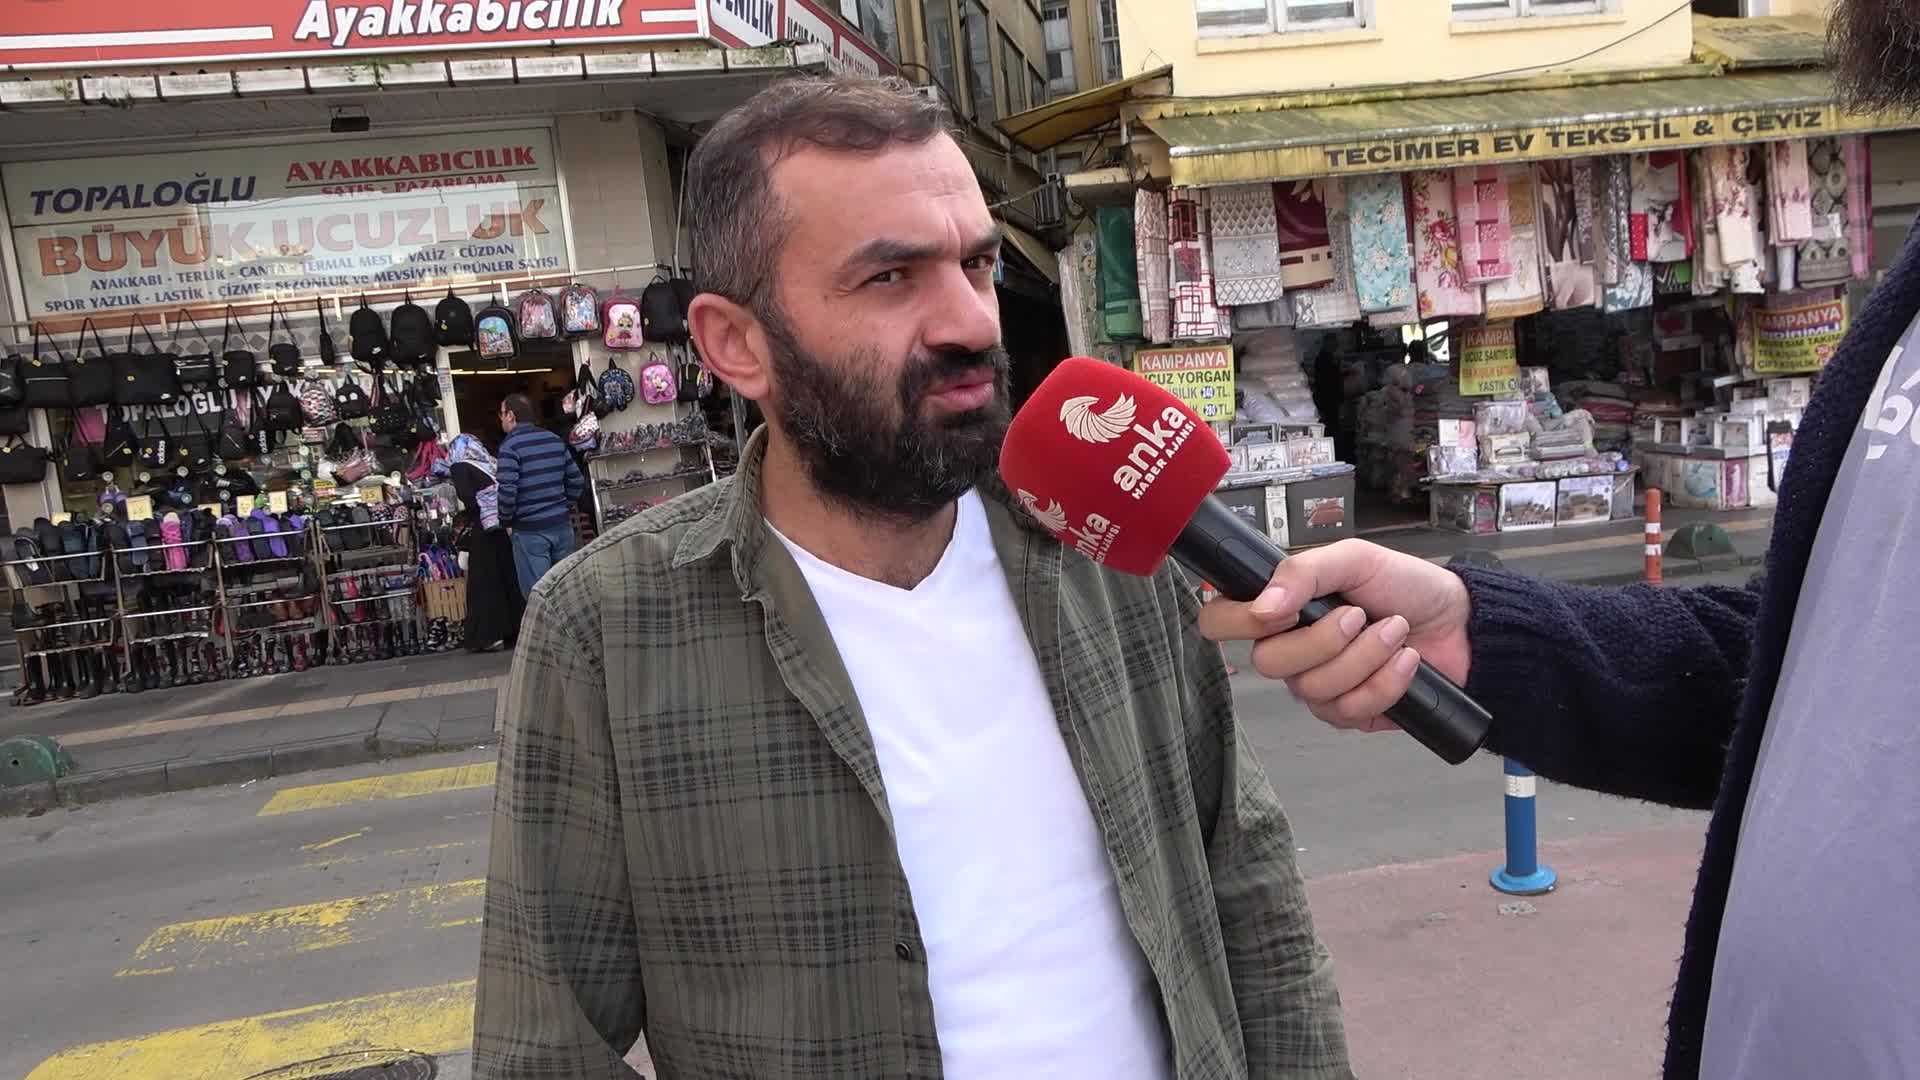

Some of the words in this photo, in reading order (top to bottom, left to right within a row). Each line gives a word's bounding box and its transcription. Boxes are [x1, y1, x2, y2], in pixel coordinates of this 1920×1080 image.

[1327, 137, 1479, 168] TECİMER
[1492, 134, 1535, 153] EV
[1545, 117, 1681, 149] TEKSTİL
[1692, 119, 1715, 137] &
[1731, 108, 1823, 138] ÇEYİZ
[286, 145, 537, 183] AYAKKABICILIK
[30, 171, 257, 217] TOPALOĞLU
[37, 216, 259, 278] BÜYÜK
[271, 198, 551, 254] UCUZLUK
[89, 273, 163, 292] AYAKKABI
[176, 267, 226, 285] TERLİK
[302, 256, 353, 275] TERMAL
[359, 253, 394, 270] MEST
[408, 247, 447, 264] VALİZ
[459, 243, 515, 259] CÜZDAN
[44, 297, 86, 313] SPOR
[90, 293, 142, 310] YAZLIK
[155, 286, 204, 304] LASTİK
[274, 274, 349, 293] SEZONLUK
[1140, 350, 1227, 372] KAMPANYA
[1143, 372, 1175, 386] CUZ
[1177, 369, 1232, 385] YORGAN
[1112, 406, 1188, 492] anka
[1131, 458, 1168, 500] HABER
[1165, 420, 1197, 459] AJANSI
[1069, 512, 1111, 561] nka
